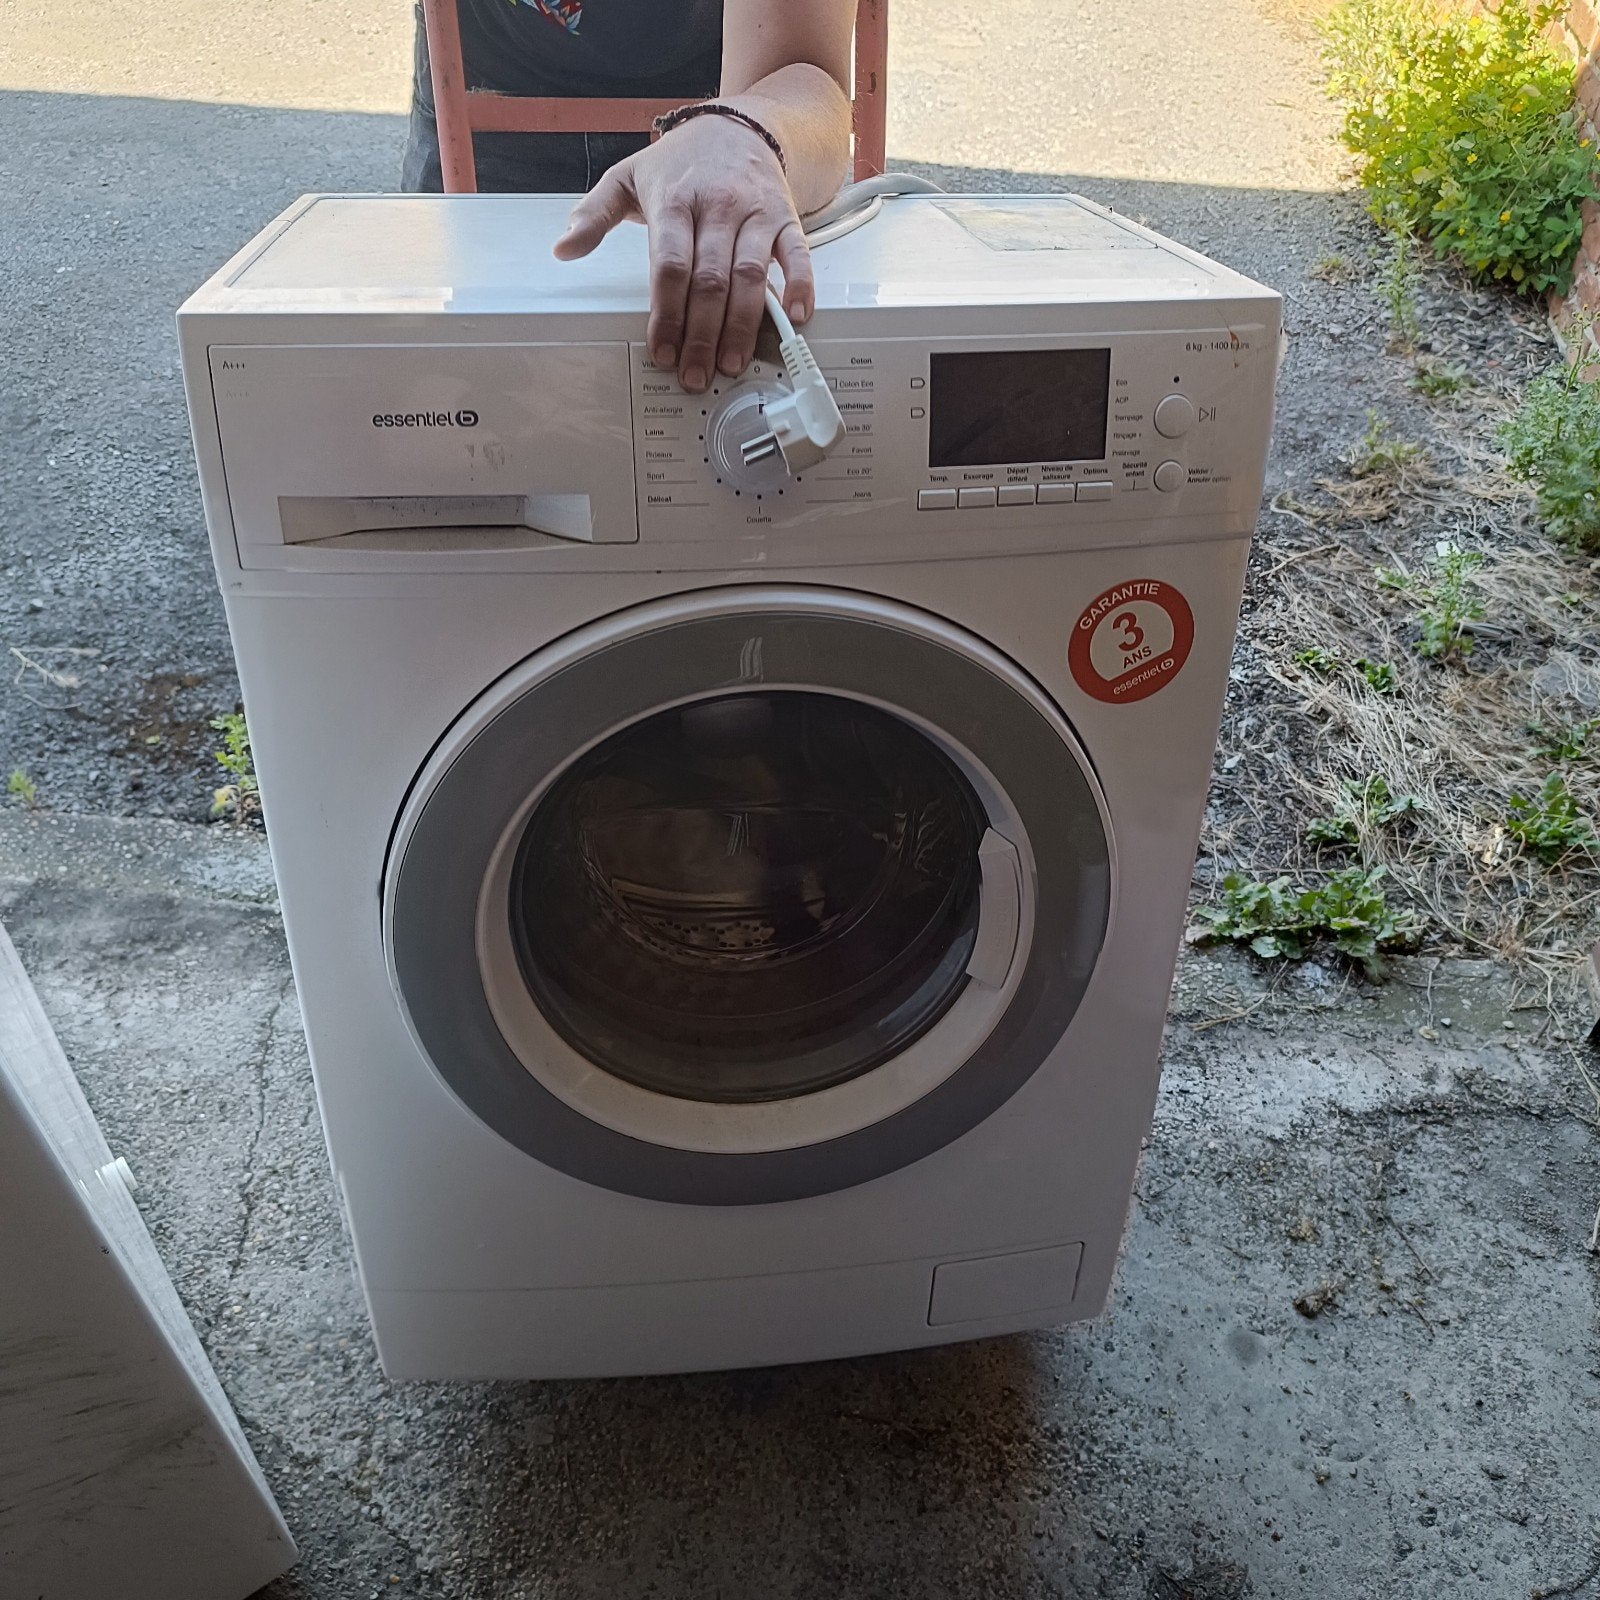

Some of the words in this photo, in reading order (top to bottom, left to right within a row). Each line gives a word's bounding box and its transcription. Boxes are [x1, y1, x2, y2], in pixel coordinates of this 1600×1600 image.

[1192, 342, 1202, 352] kg
[1210, 341, 1229, 351] 1400
[372, 411, 454, 427] essentiel
[1080, 582, 1160, 630] GARANTIE
[1112, 611, 1145, 652] 3
[1123, 645, 1152, 669] ANS
[1113, 664, 1162, 695] essentiel
